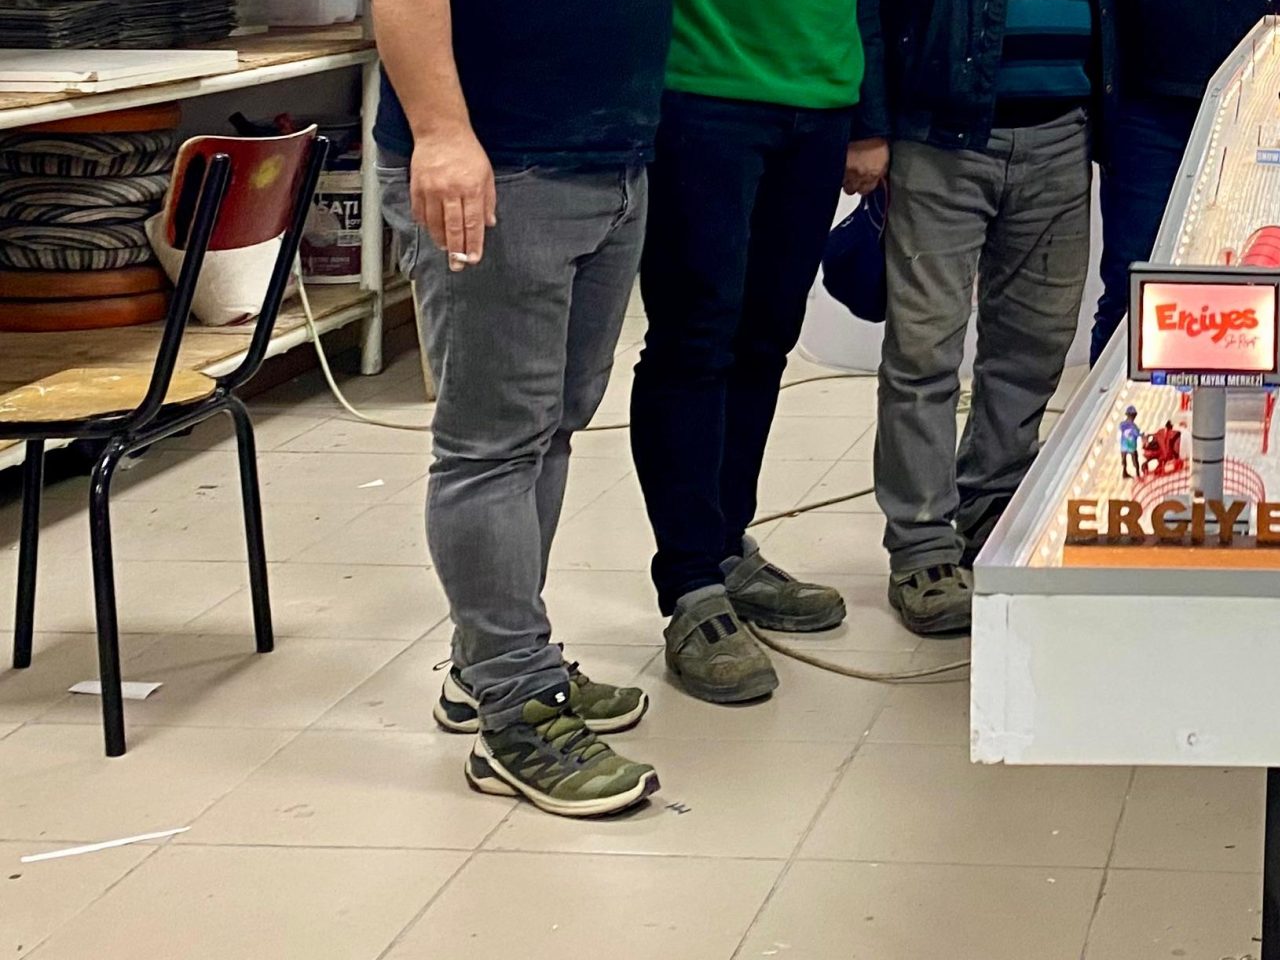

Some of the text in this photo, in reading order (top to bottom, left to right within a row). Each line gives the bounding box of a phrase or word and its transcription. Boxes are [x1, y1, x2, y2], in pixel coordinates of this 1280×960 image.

[1156, 303, 1259, 344] Erciyes
[1166, 372, 1199, 386] ERCİYES
[1200, 374, 1226, 386] KAYAK
